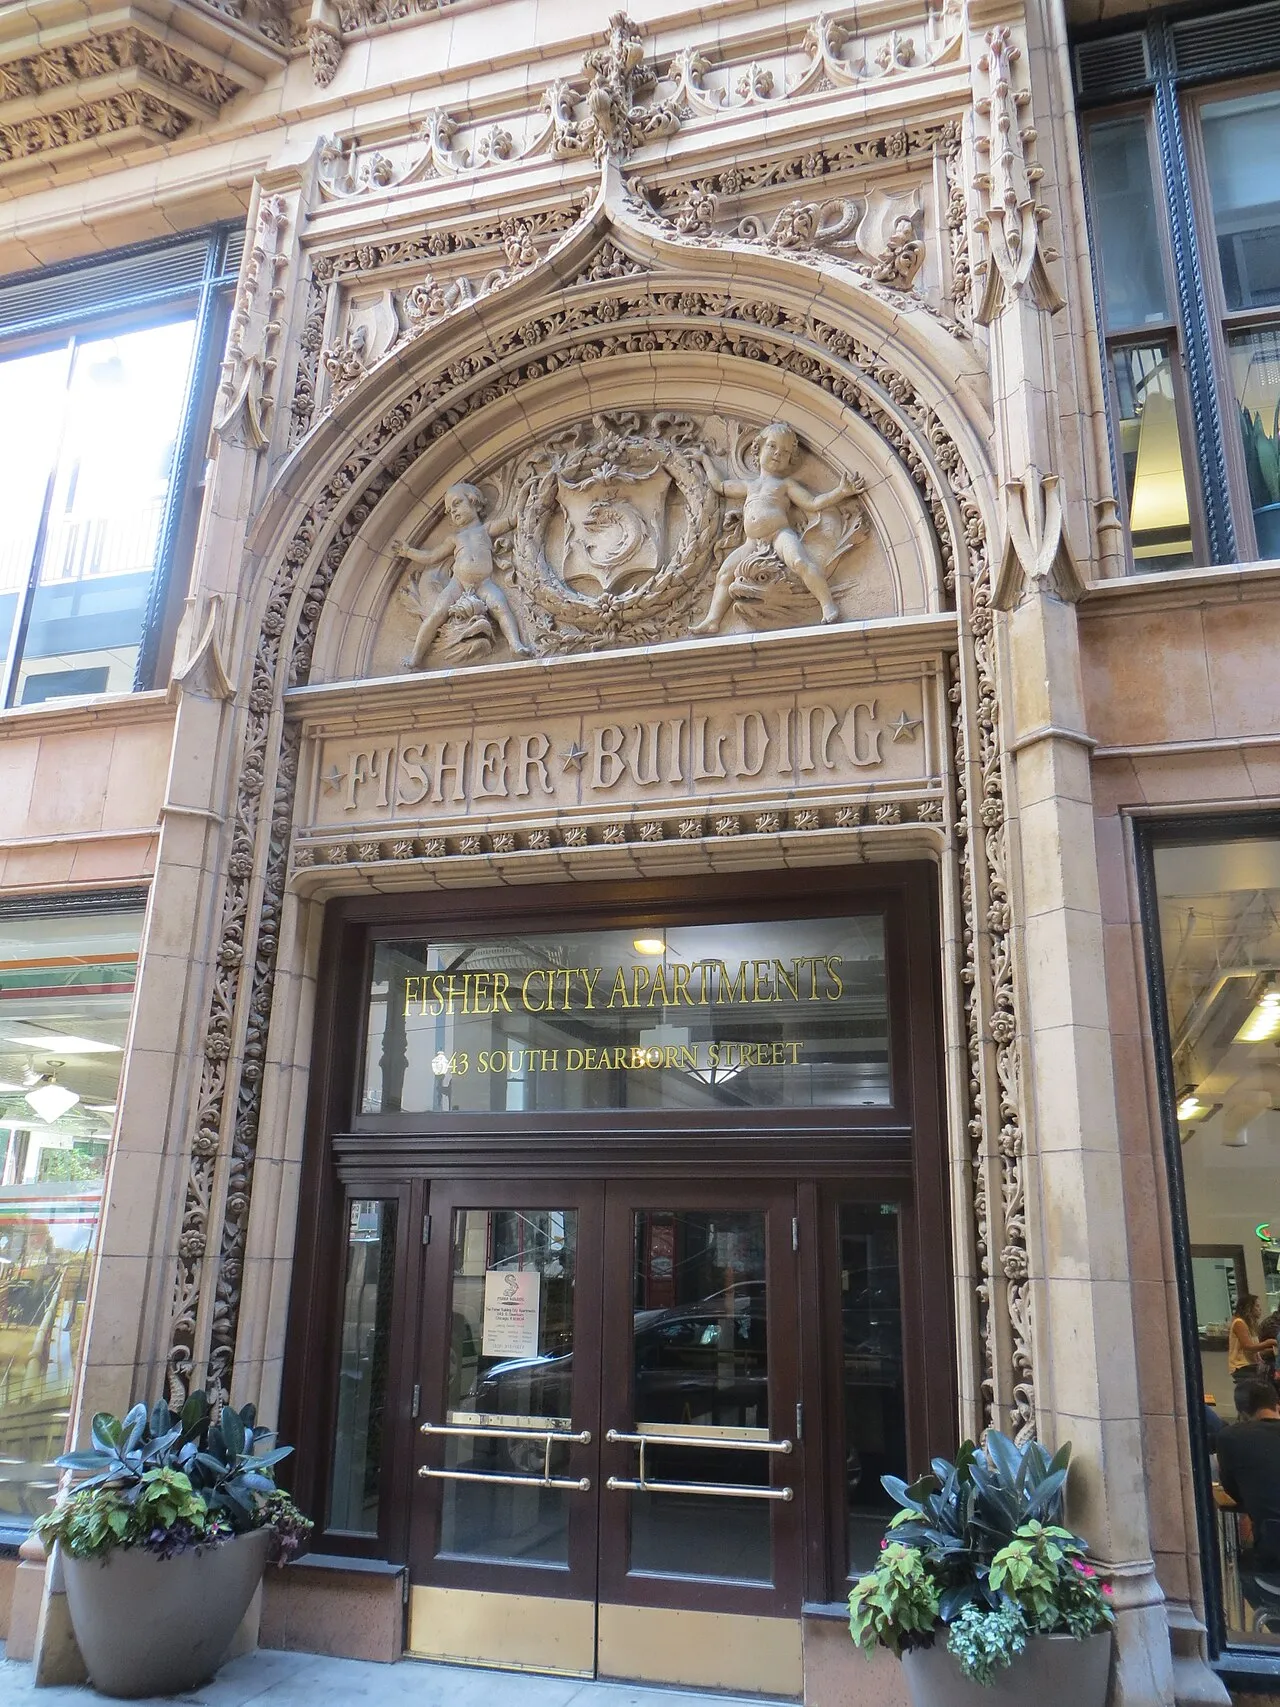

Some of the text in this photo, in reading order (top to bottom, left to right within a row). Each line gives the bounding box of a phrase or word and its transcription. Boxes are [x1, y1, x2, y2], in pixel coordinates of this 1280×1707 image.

[343, 700, 882, 811] FISHER BUILDING
[402, 957, 844, 1016] FISHER CITY APARTMENTS
[477, 1050, 558, 1074] SOUTH
[566, 1047, 698, 1070] DEARBORN
[707, 1042, 803, 1067] STREET
